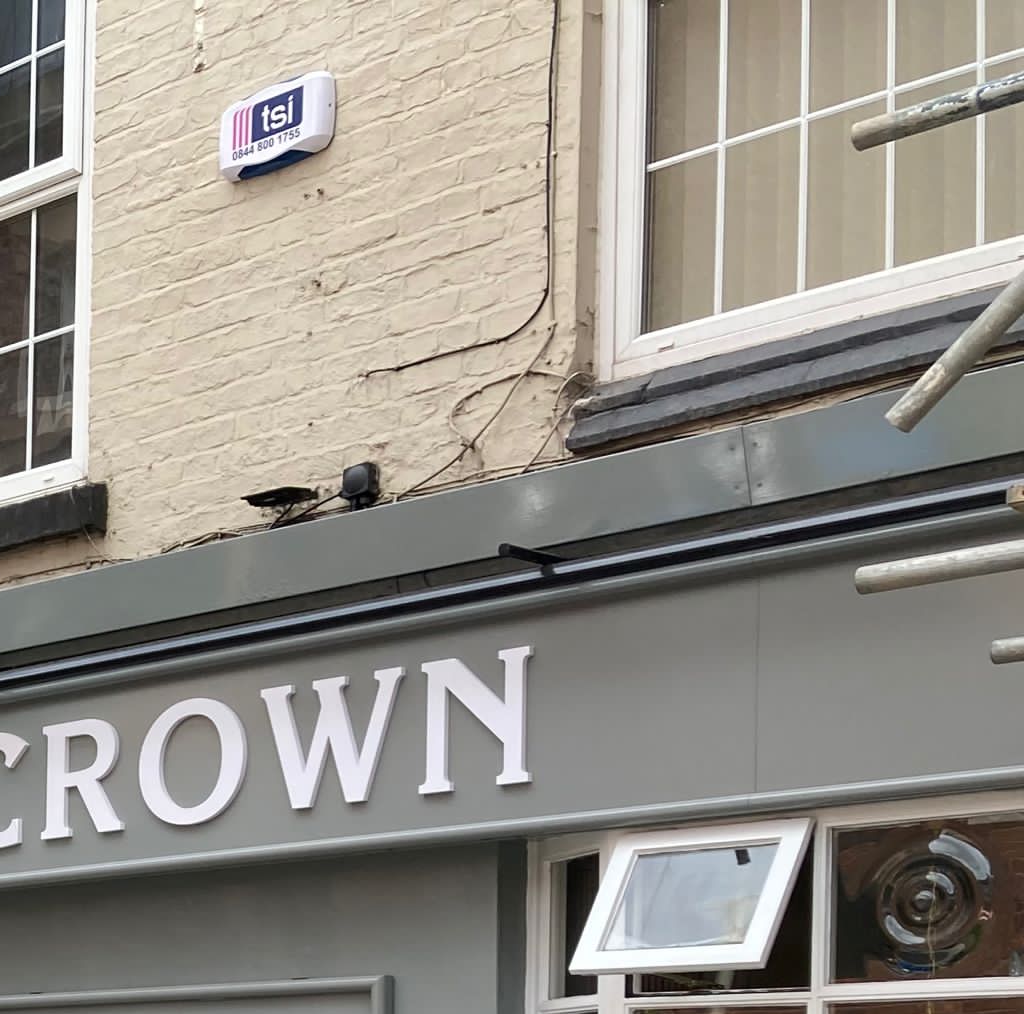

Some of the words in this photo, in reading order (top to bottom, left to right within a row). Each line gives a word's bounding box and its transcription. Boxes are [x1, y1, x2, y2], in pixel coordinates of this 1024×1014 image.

[261, 95, 294, 132] tsi
[232, 145, 254, 161] 0844
[257, 137, 275, 152] 800
[278, 127, 301, 144] 1755
